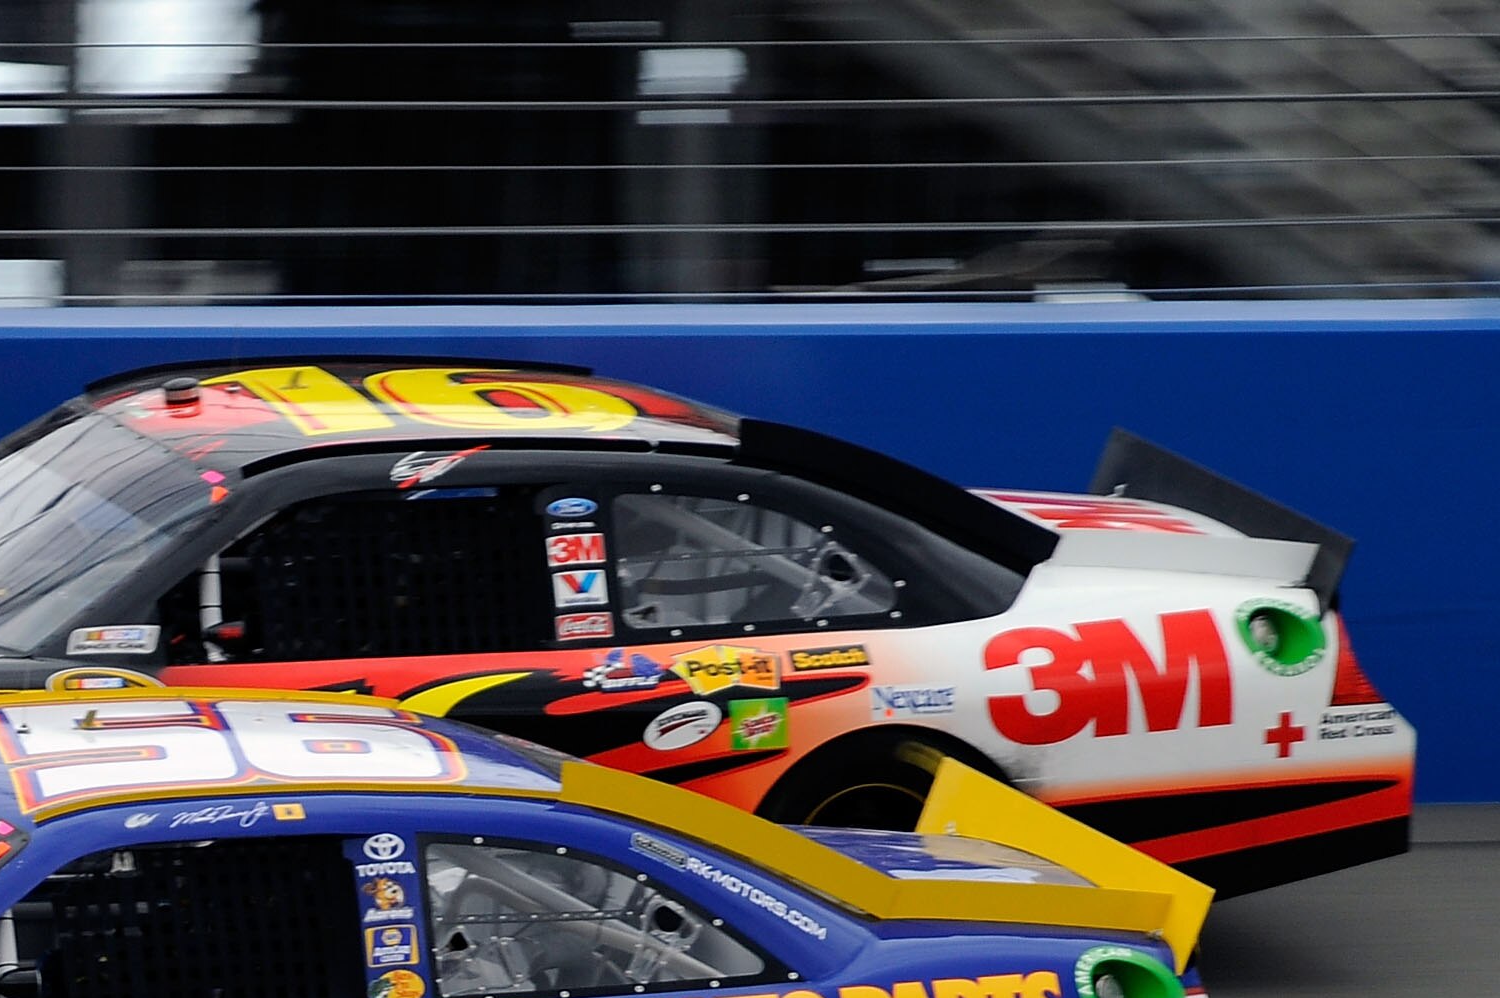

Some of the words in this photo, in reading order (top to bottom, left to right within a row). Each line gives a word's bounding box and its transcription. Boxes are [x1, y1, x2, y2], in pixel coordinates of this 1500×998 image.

[200, 366, 638, 436] 16
[551, 535, 604, 563] 3M
[686, 655, 772, 677] Post-it
[792, 650, 867, 669] Scotch
[982, 609, 1233, 746] 3M
[1321, 709, 1395, 725] American
[1320, 728, 1347, 740] Red
[1353, 726, 1394, 738] Cross
[355, 862, 416, 877] TOYOTA
